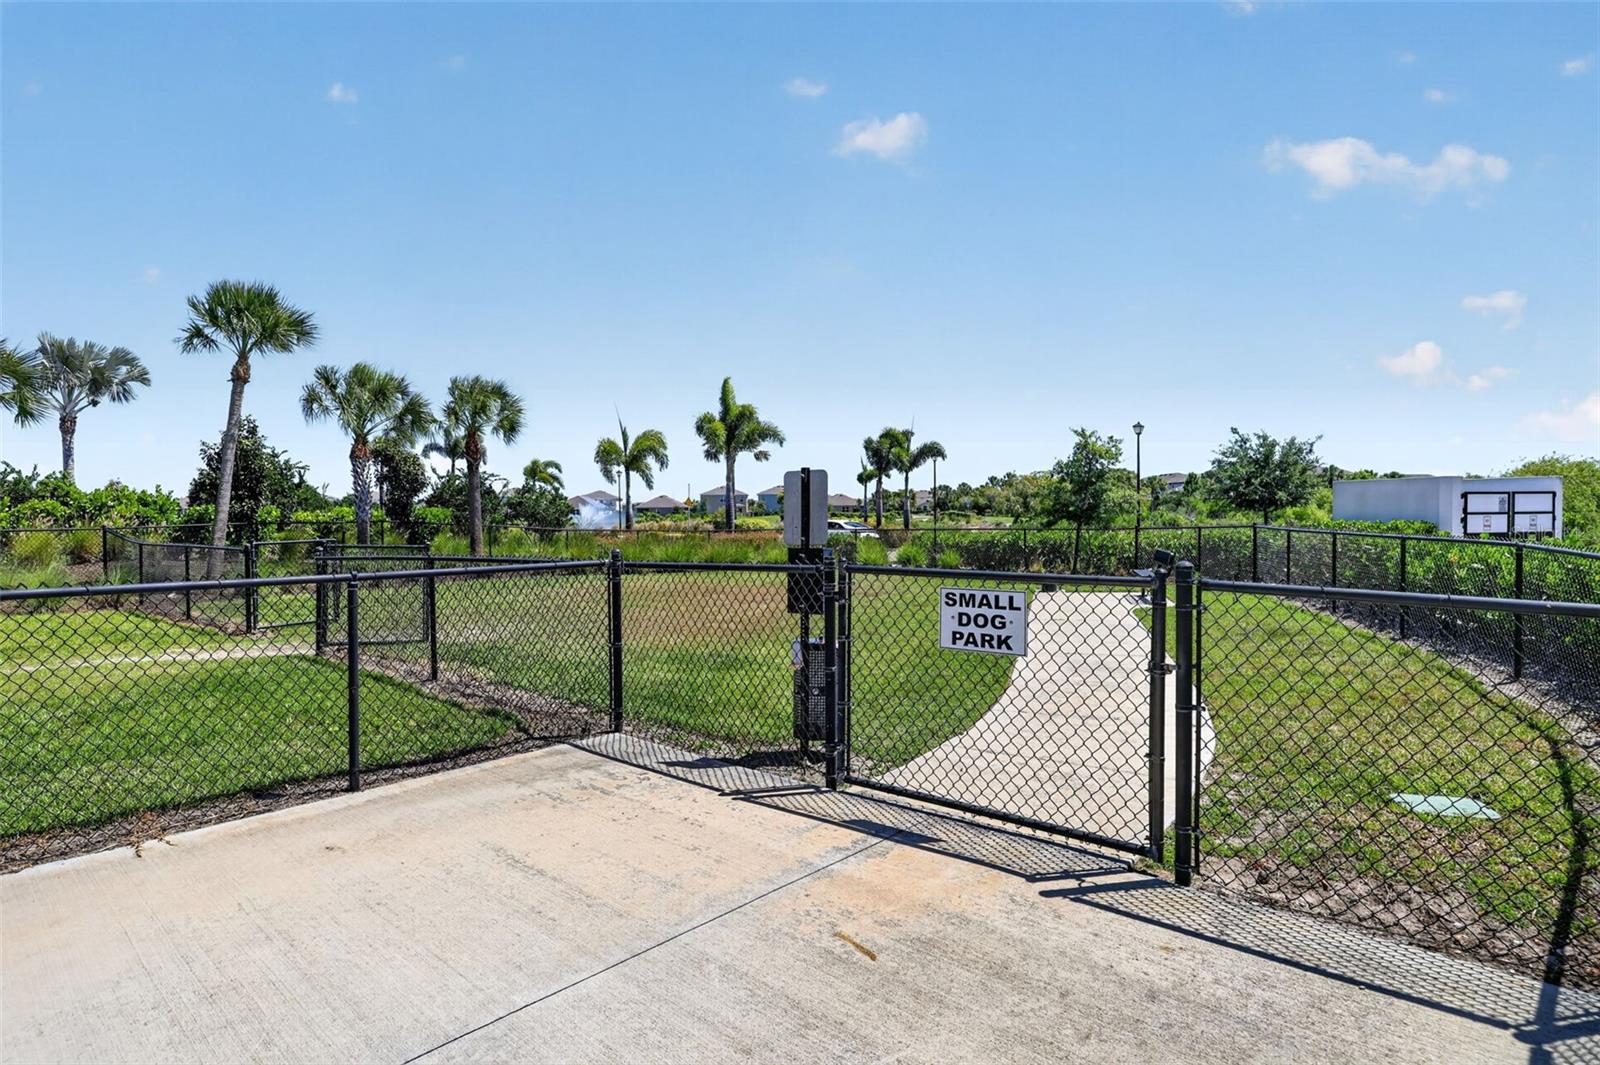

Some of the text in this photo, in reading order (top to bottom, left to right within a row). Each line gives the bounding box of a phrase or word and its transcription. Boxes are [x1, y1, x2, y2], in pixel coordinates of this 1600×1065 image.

[944, 592, 1021, 611] SMALL
[958, 612, 1006, 630] DOG
[951, 631, 1013, 651] PARK
